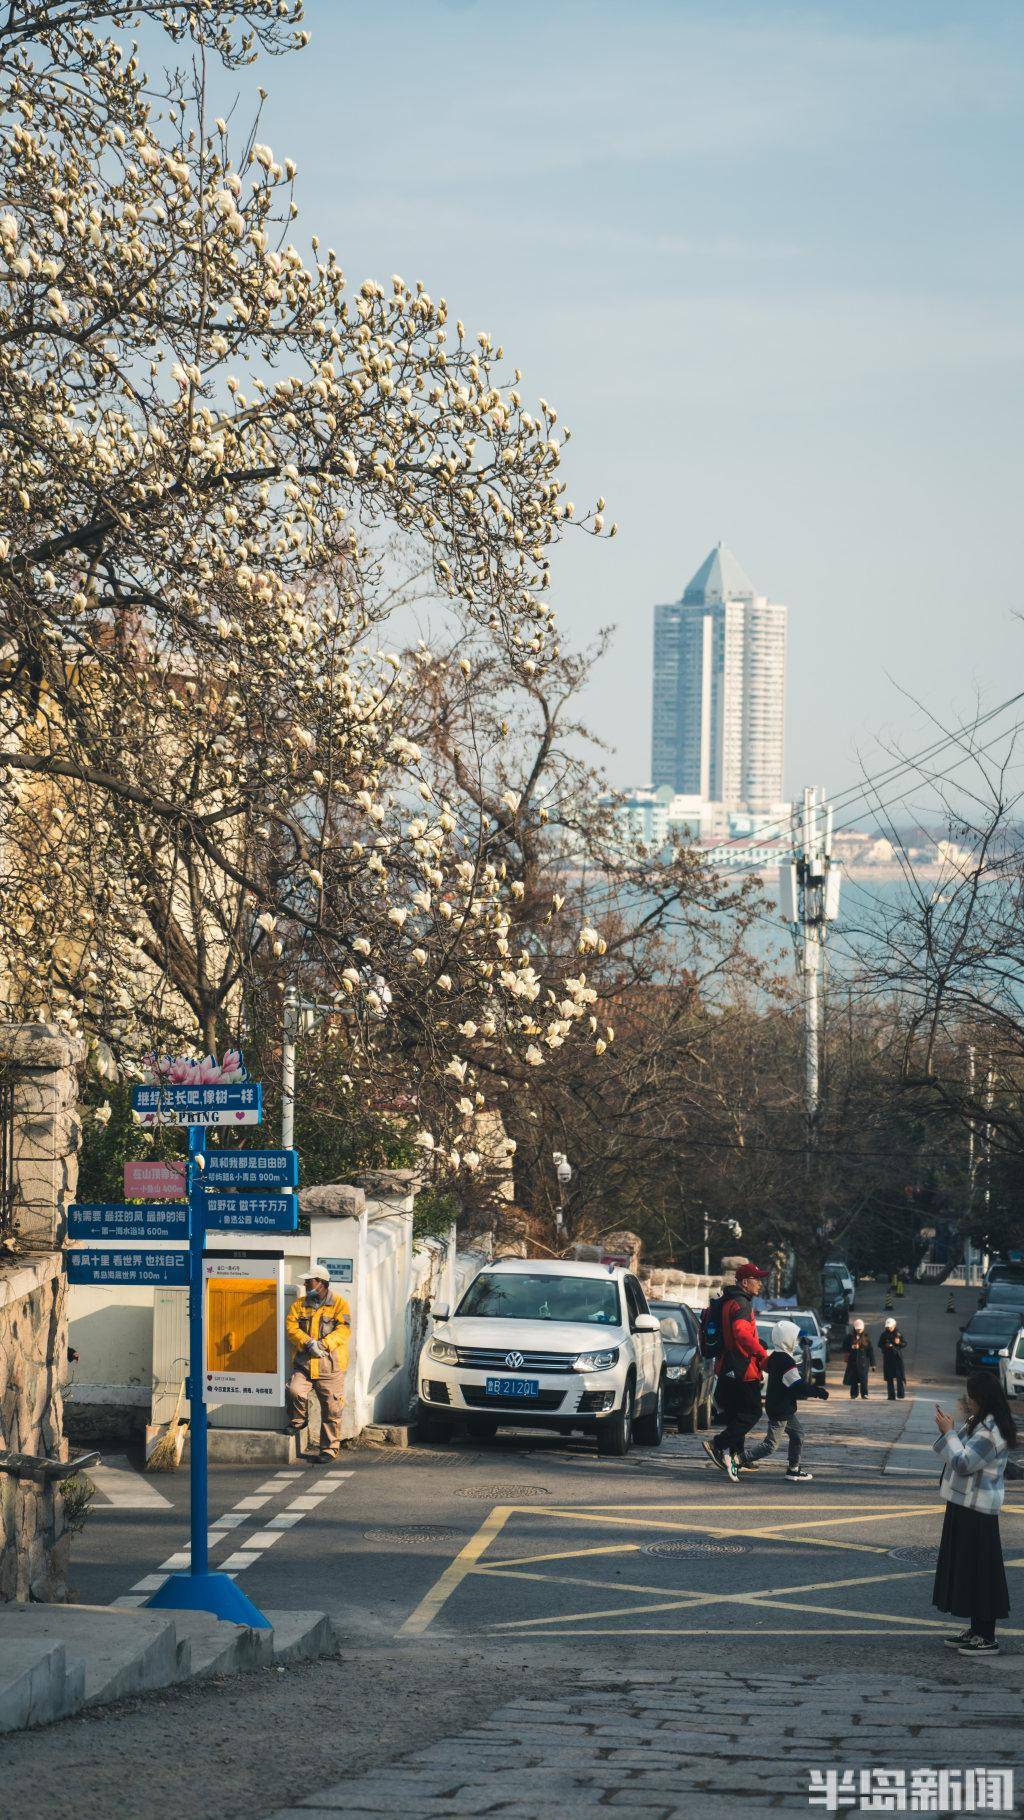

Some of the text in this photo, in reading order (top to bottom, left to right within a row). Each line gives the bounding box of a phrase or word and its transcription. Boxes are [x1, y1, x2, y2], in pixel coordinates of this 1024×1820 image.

[173, 1111, 219, 1123] PRING
[210, 1156, 287, 1169] 风和我都是自由的
[258, 1173, 280, 1181] 900m
[254, 1216, 275, 1225] 400m
[147, 1227, 169, 1236] 600m
[139, 1271, 160, 1280] 100m
